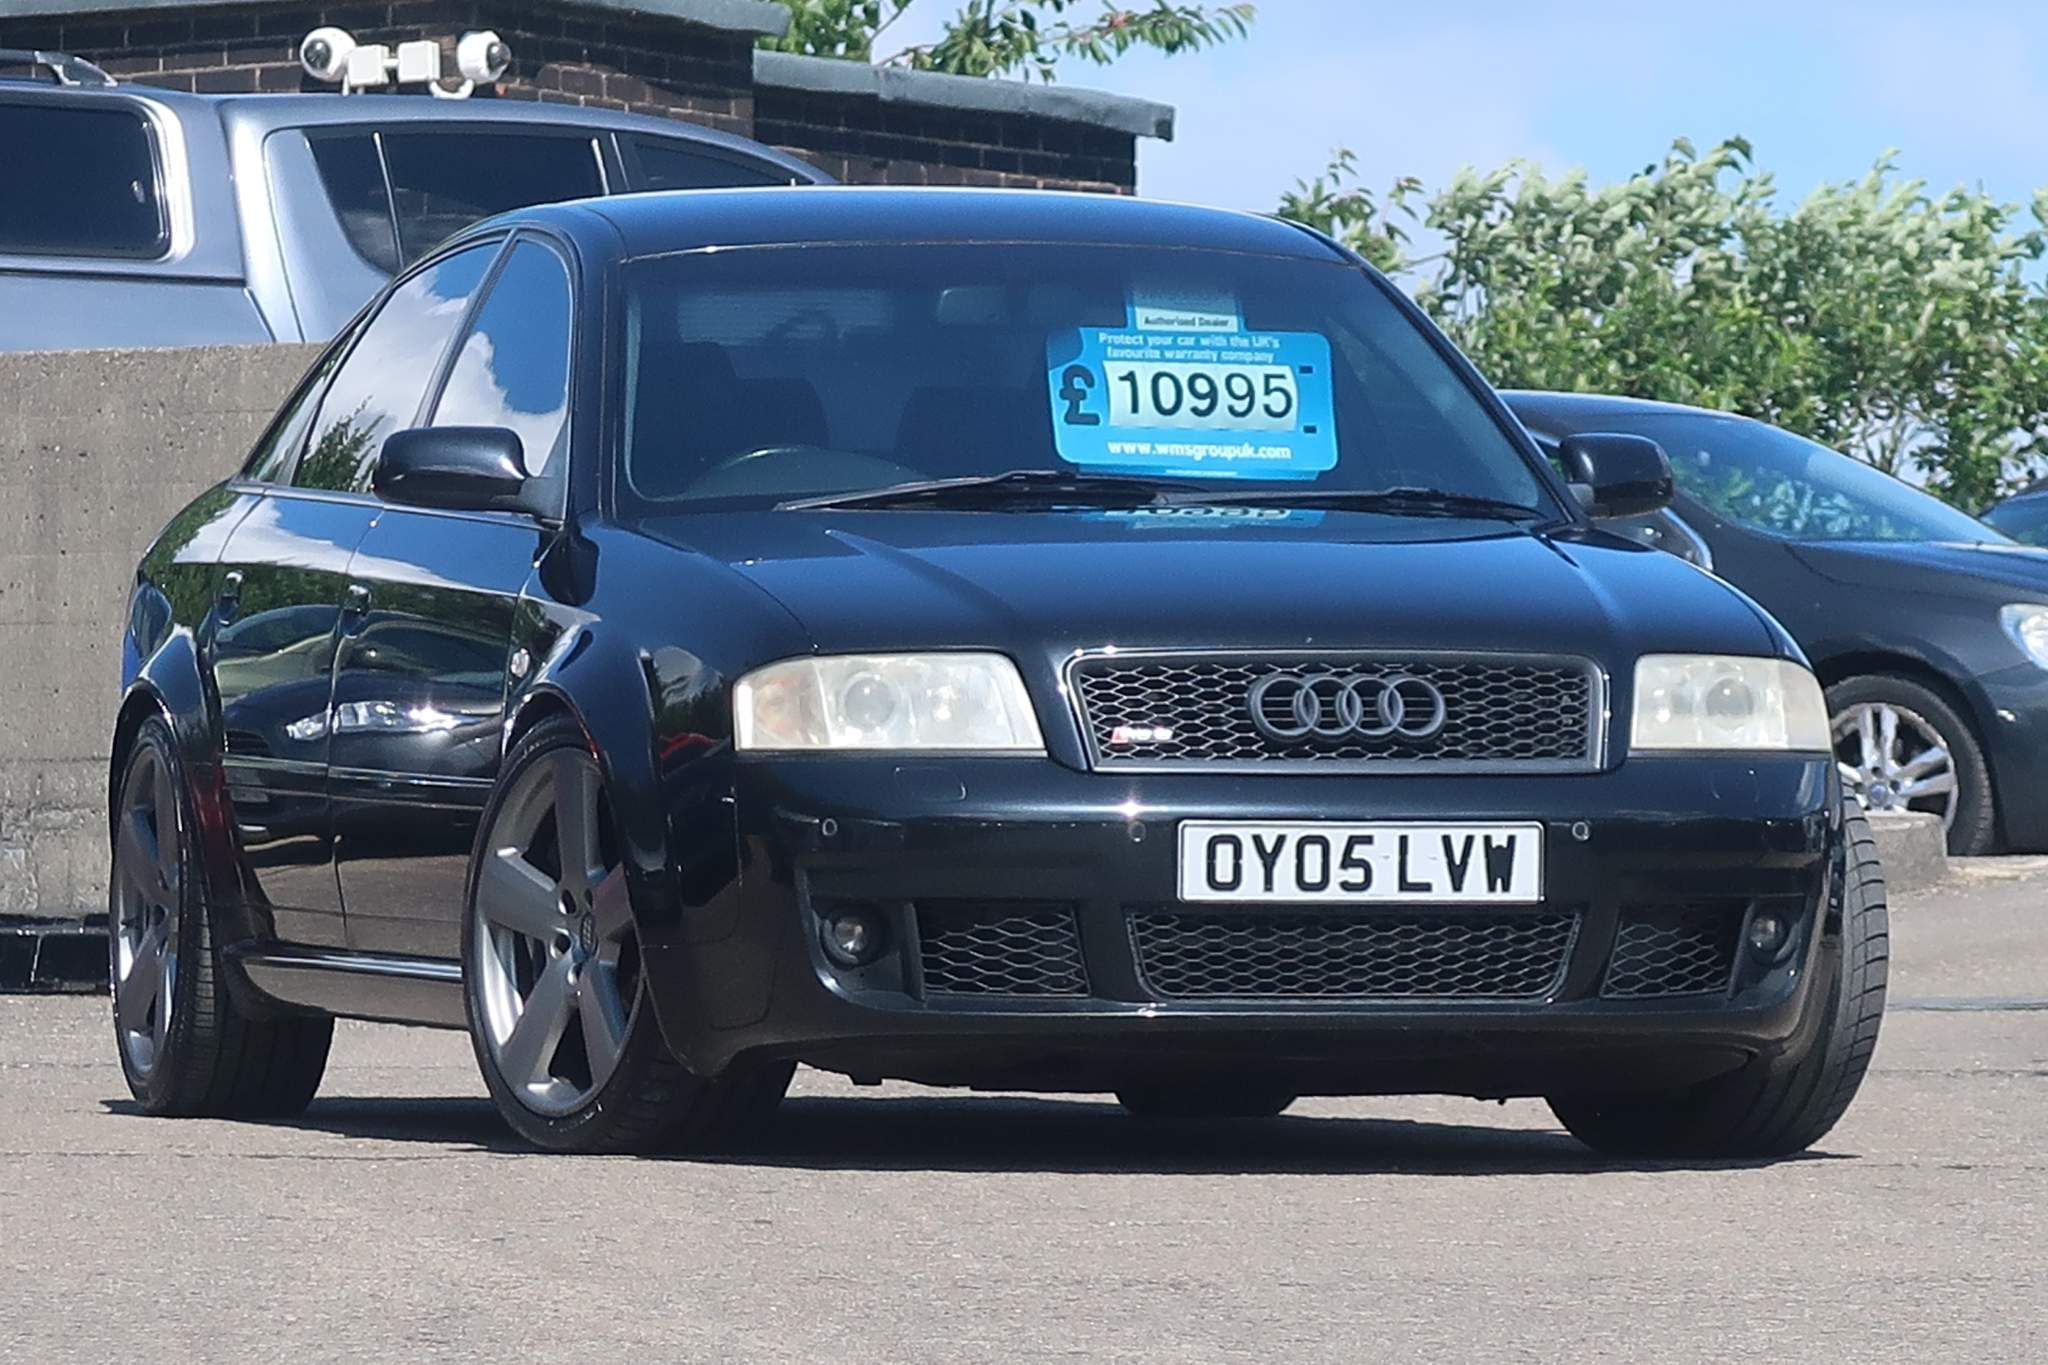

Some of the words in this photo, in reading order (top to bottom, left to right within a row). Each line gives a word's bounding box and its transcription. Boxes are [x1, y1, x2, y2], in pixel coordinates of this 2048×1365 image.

[1099, 333, 1144, 345] Protect
[1148, 336, 1173, 348] your
[1177, 337, 1195, 346] car
[1201, 335, 1227, 346] with
[1230, 336, 1250, 347] the
[1252, 336, 1280, 348] UK's
[1107, 346, 1161, 359] favourite
[1164, 349, 1218, 362] warranty
[1221, 351, 1275, 364] company
[1118, 370, 1293, 418] 10995
[1107, 440, 1292, 461] www.wmsgroupuk.com
[1206, 834, 1374, 892] OY05
[1398, 834, 1517, 893] LVW
